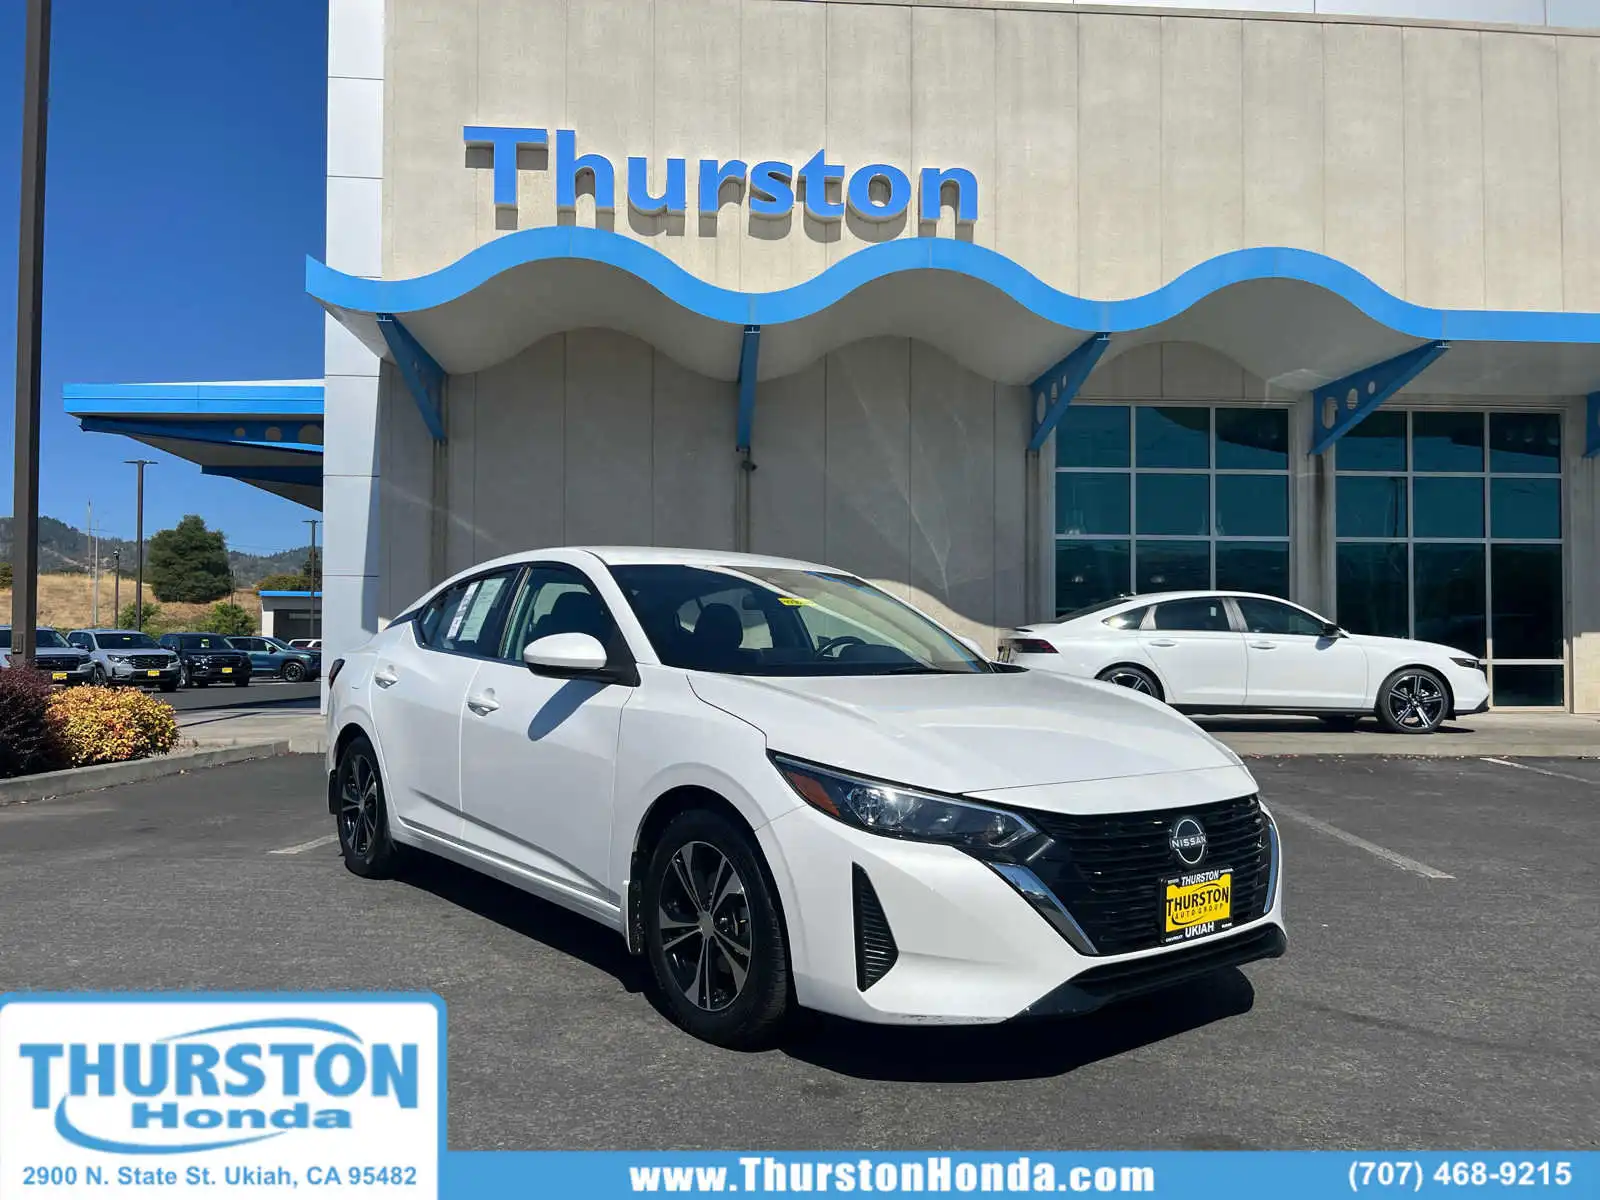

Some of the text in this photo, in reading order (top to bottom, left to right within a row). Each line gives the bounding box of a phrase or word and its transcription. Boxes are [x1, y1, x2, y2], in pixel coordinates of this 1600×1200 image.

[463, 125, 978, 222] Thurston
[1171, 835, 1207, 849] NISSAN
[1181, 870, 1220, 887] THURSTON
[1166, 886, 1229, 917] THURSTON
[1175, 909, 1196, 920] AUTO
[1185, 921, 1215, 938] UKIAH
